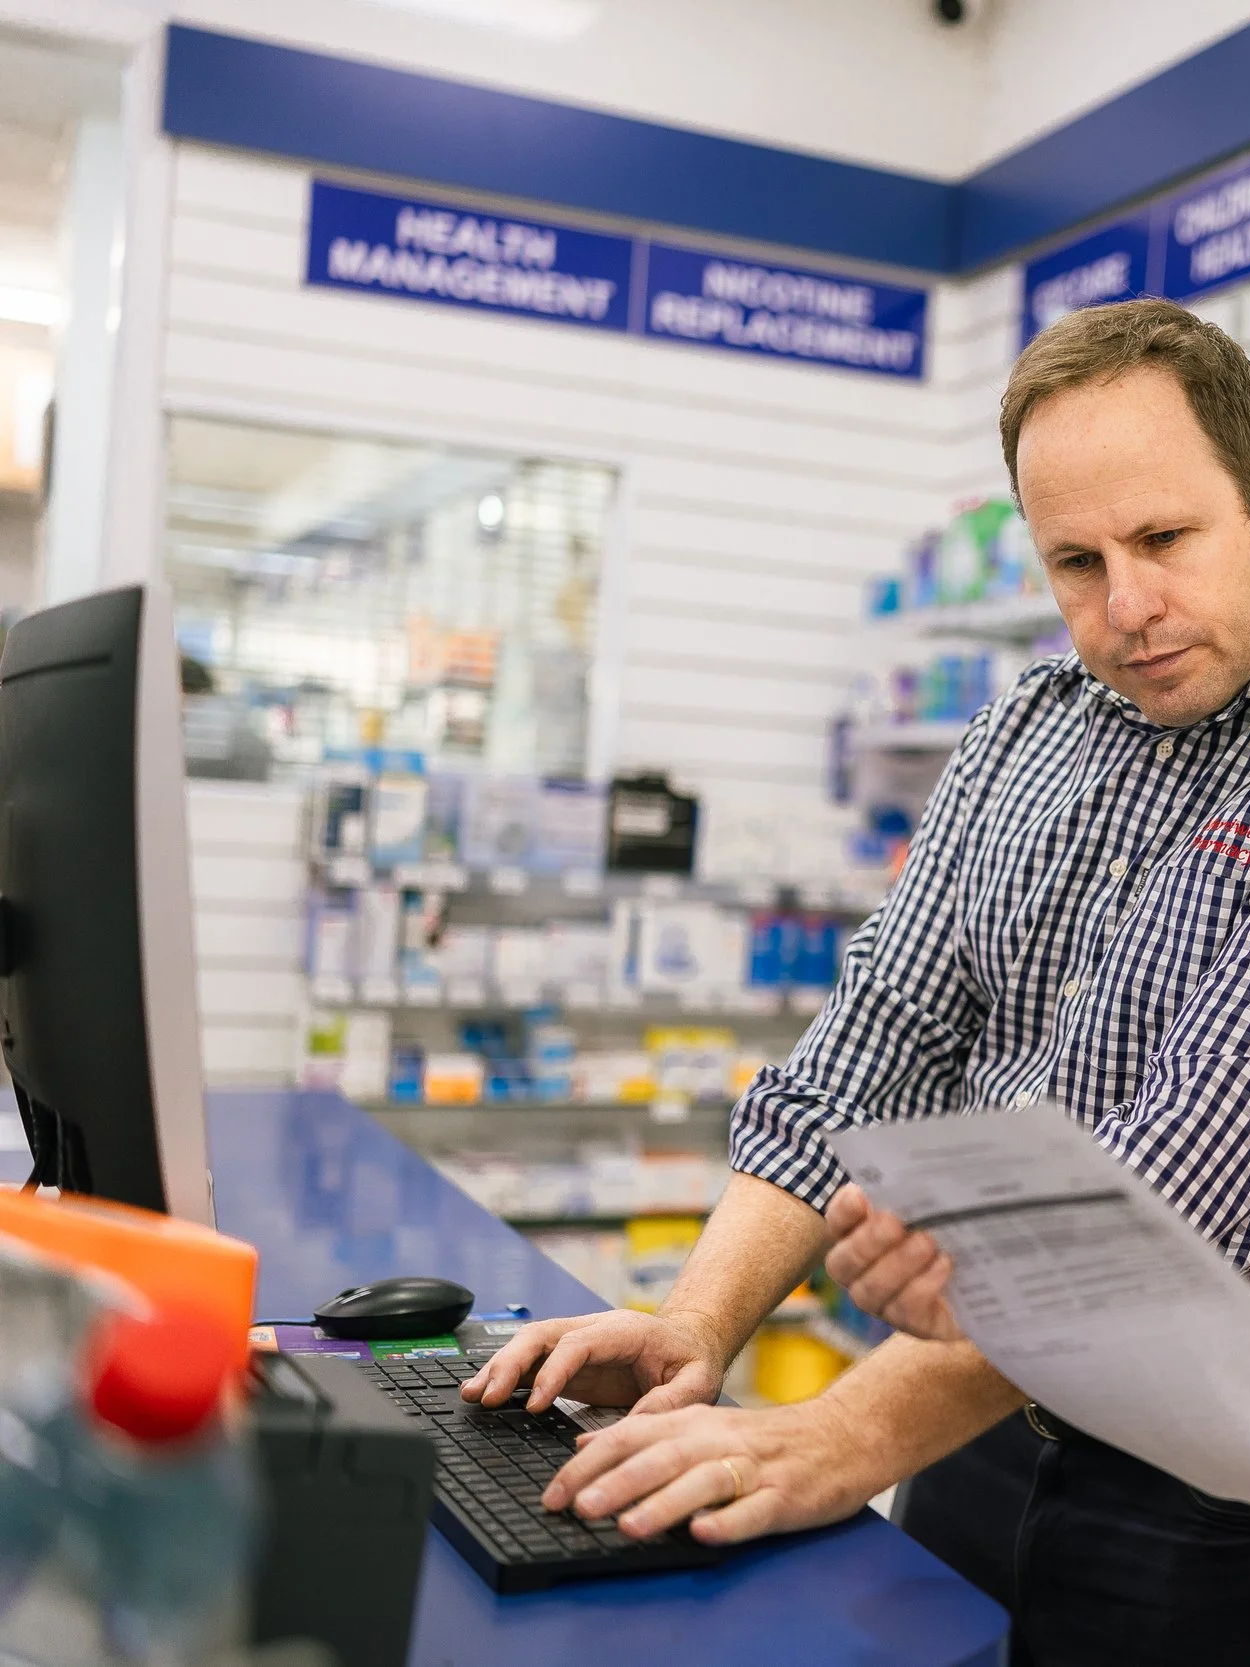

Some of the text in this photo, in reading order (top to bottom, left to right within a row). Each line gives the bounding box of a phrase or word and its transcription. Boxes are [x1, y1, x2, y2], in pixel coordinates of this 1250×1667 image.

[396, 206, 556, 271] HEALTH
[328, 238, 617, 321] MANAGEMENT
[703, 262, 876, 327] NICOTINE
[653, 291, 917, 371] REPLACEMENT
